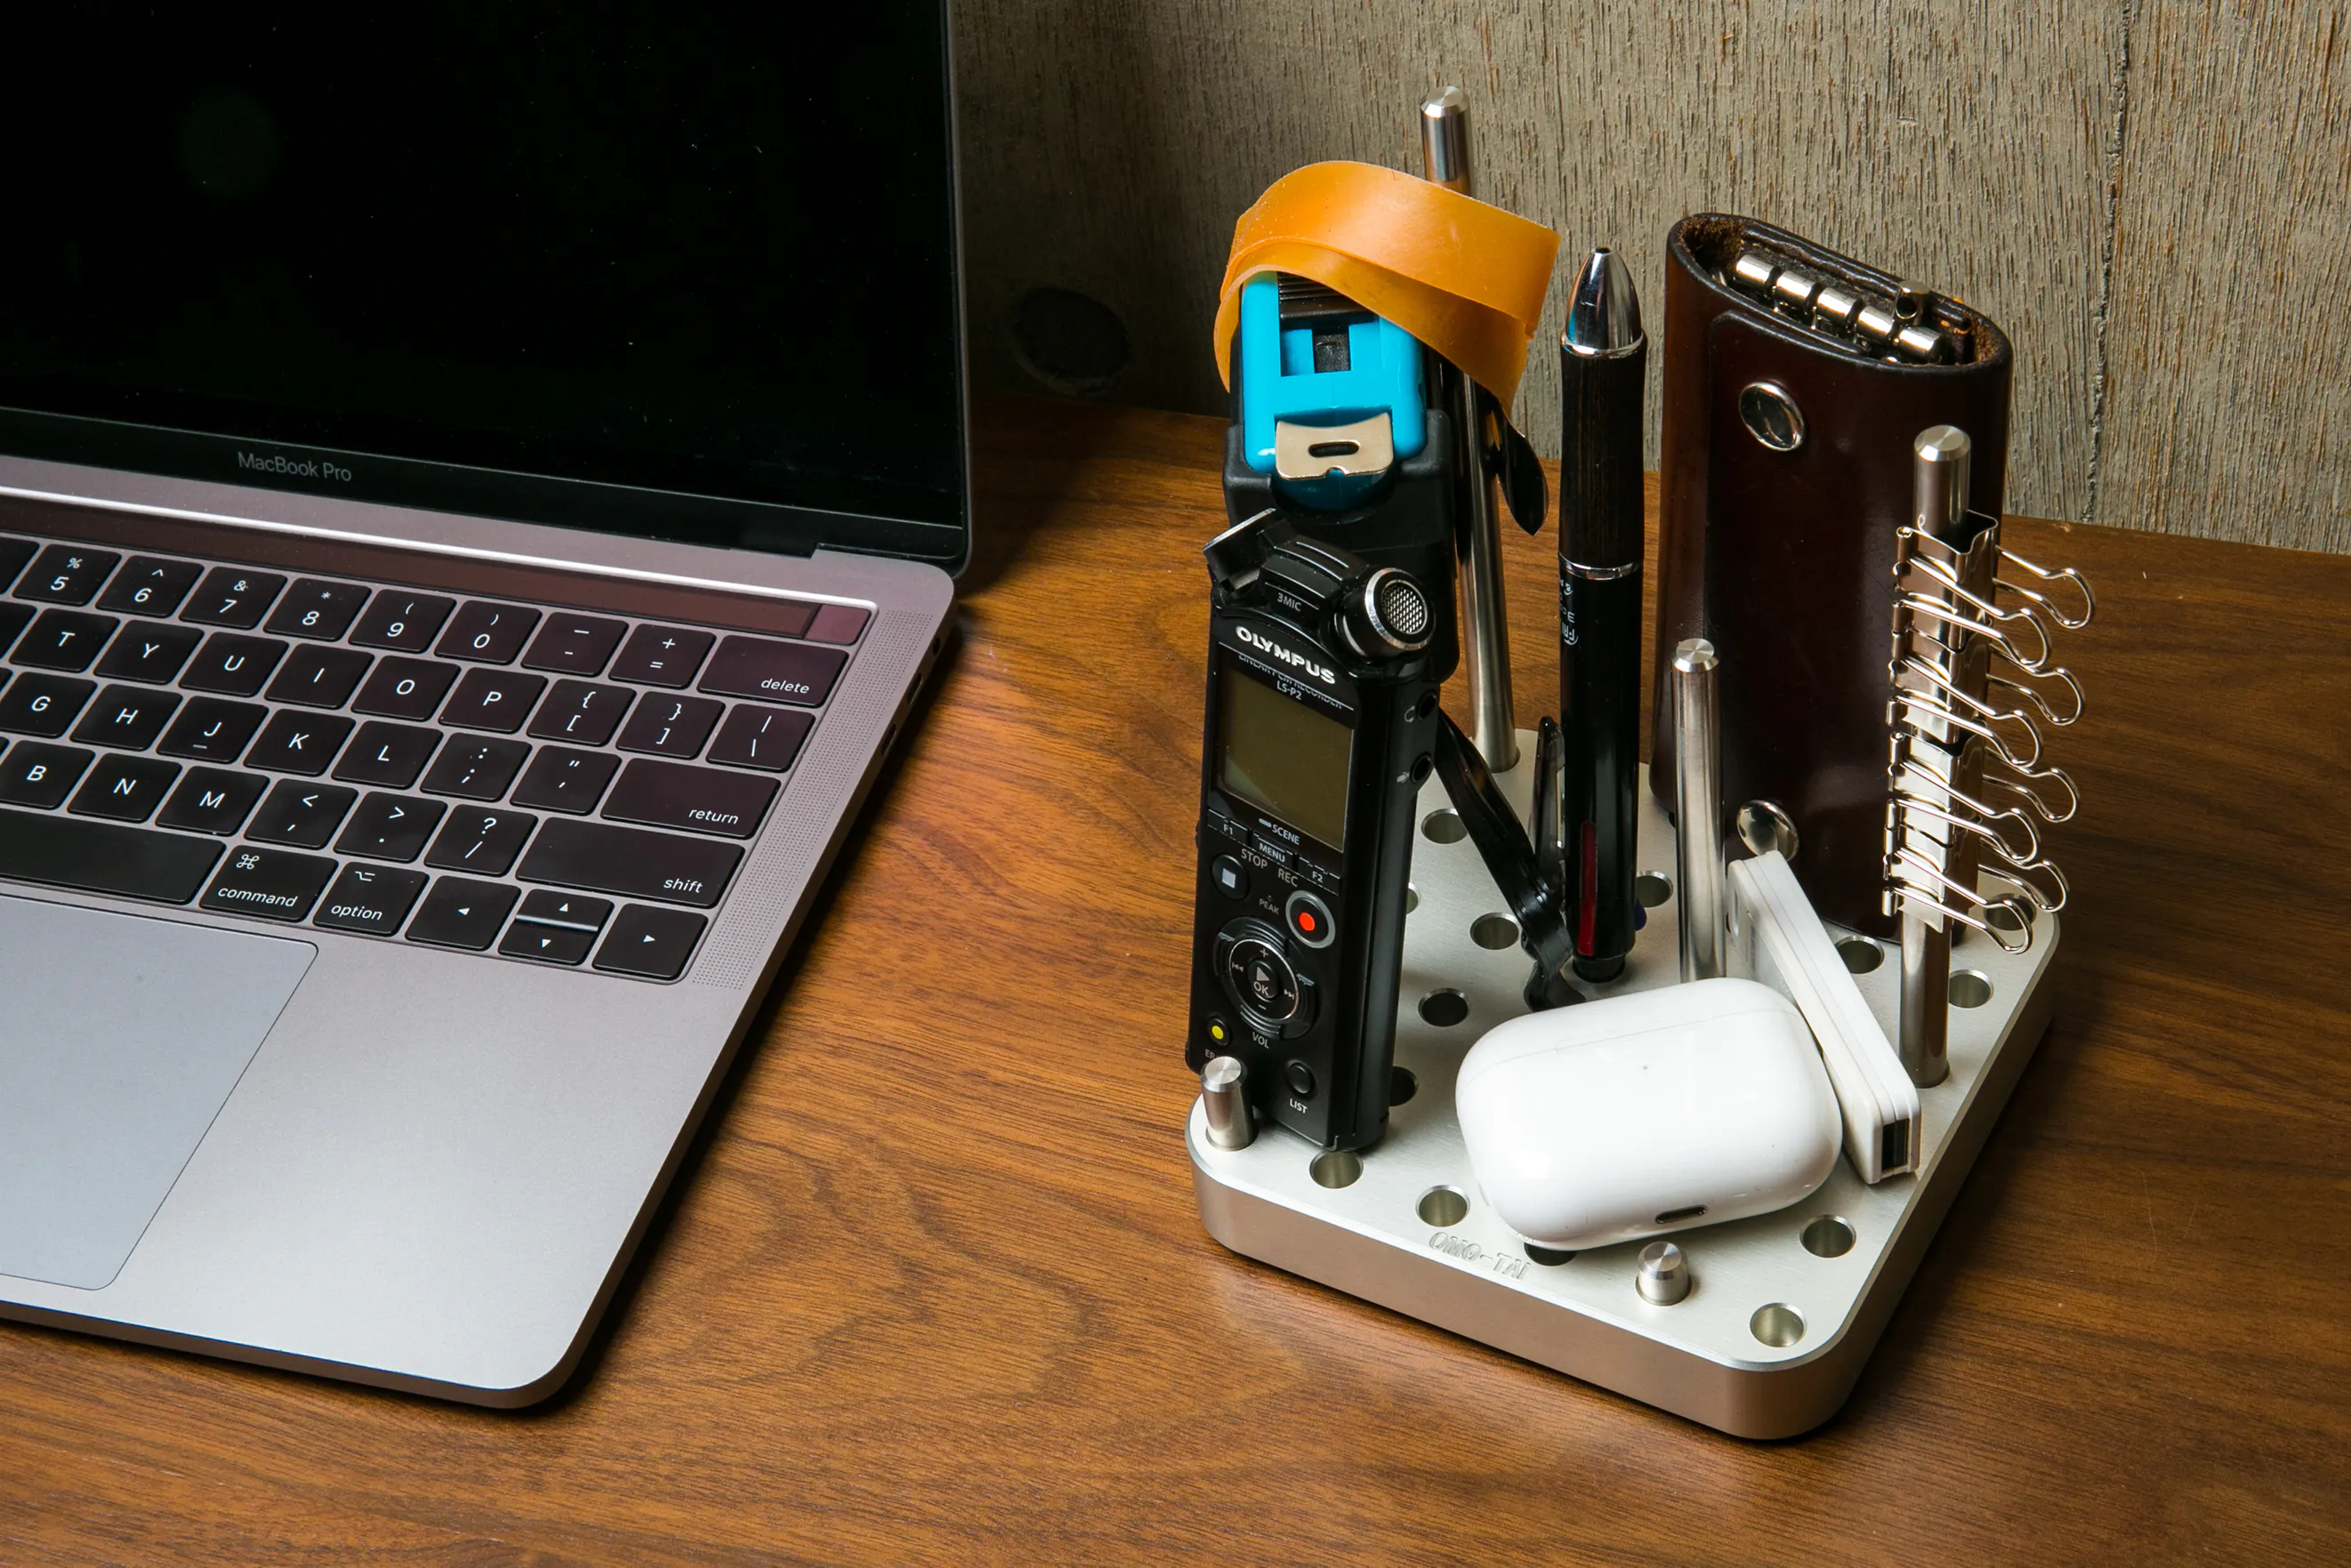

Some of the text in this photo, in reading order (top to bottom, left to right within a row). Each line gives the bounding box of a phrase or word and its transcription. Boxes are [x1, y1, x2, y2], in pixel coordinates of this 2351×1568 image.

[237, 450, 352, 482] MacBook Pro
[50, 575, 69, 591] 5
[133, 587, 152, 603] 6
[1276, 591, 1302, 613] 3MIC
[219, 599, 238, 614] 7
[302, 610, 320, 626] 8
[386, 622, 405, 638] 9
[58, 631, 76, 647] T
[473, 633, 491, 649] 0
[141, 643, 160, 659] Y
[1235, 624, 1336, 685] OLYMPUS
[223, 655, 246, 671] U
[313, 667, 326, 683] I
[396, 679, 415, 696] O
[761, 678, 809, 694] delete
[1276, 680, 1302, 701] LS-P2
[30, 696, 52, 712] G
[482, 690, 503, 706] P
[115, 708, 139, 725] H
[203, 721, 222, 737] J
[287, 733, 310, 750] K
[751, 738, 757, 758] \
[376, 744, 390, 762] L
[26, 765, 47, 782] B
[112, 777, 137, 795] N
[198, 791, 226, 808] M
[688, 809, 739, 824] return
[1223, 824, 1233, 835] F1
[1272, 824, 1300, 845] SCENE
[1241, 848, 1268, 869] STOP
[1259, 842, 1285, 863] MENU
[1277, 867, 1299, 888] REC
[1312, 871, 1324, 882] F2
[663, 878, 703, 894] shift
[217, 886, 299, 909] command
[330, 905, 383, 921] option
[1259, 898, 1279, 915] PEAK
[1253, 981, 1269, 996] OK
[1252, 1032, 1269, 1049] VOL
[1289, 1098, 1308, 1114] LIST
